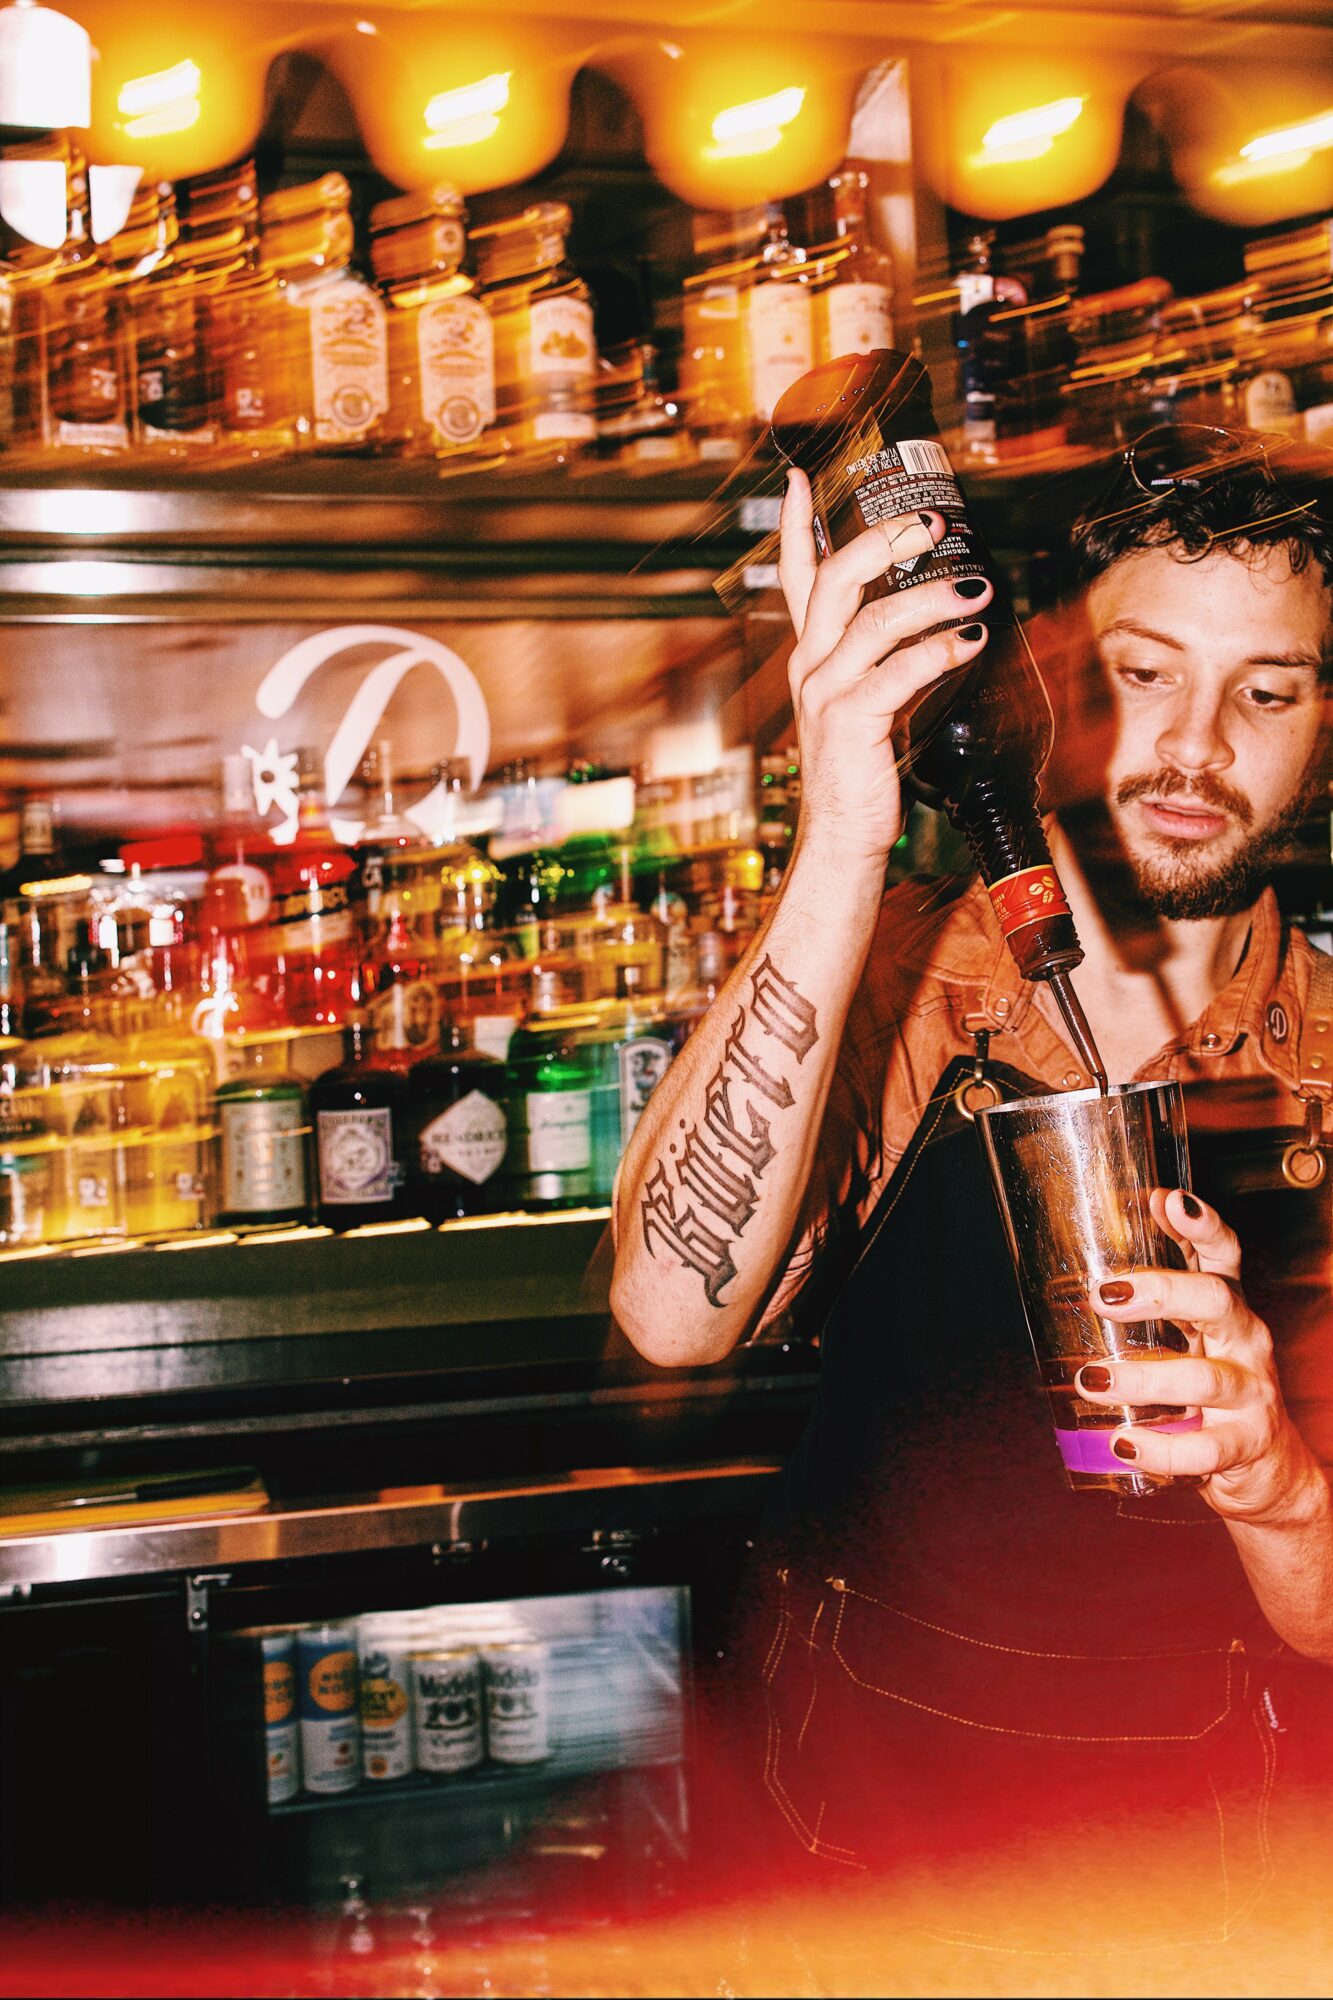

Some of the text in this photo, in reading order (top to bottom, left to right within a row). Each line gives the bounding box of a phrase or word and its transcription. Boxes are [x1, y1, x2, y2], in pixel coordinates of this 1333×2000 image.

[891, 456, 901, 466] CA
[876, 464, 903, 478] PRODUCT
[934, 542, 965, 551] ESPRESS
[931, 548, 969, 558] BORGHETTI
[951, 563, 984, 571] ITALIAN
[898, 566, 948, 589] ESPRESSO
